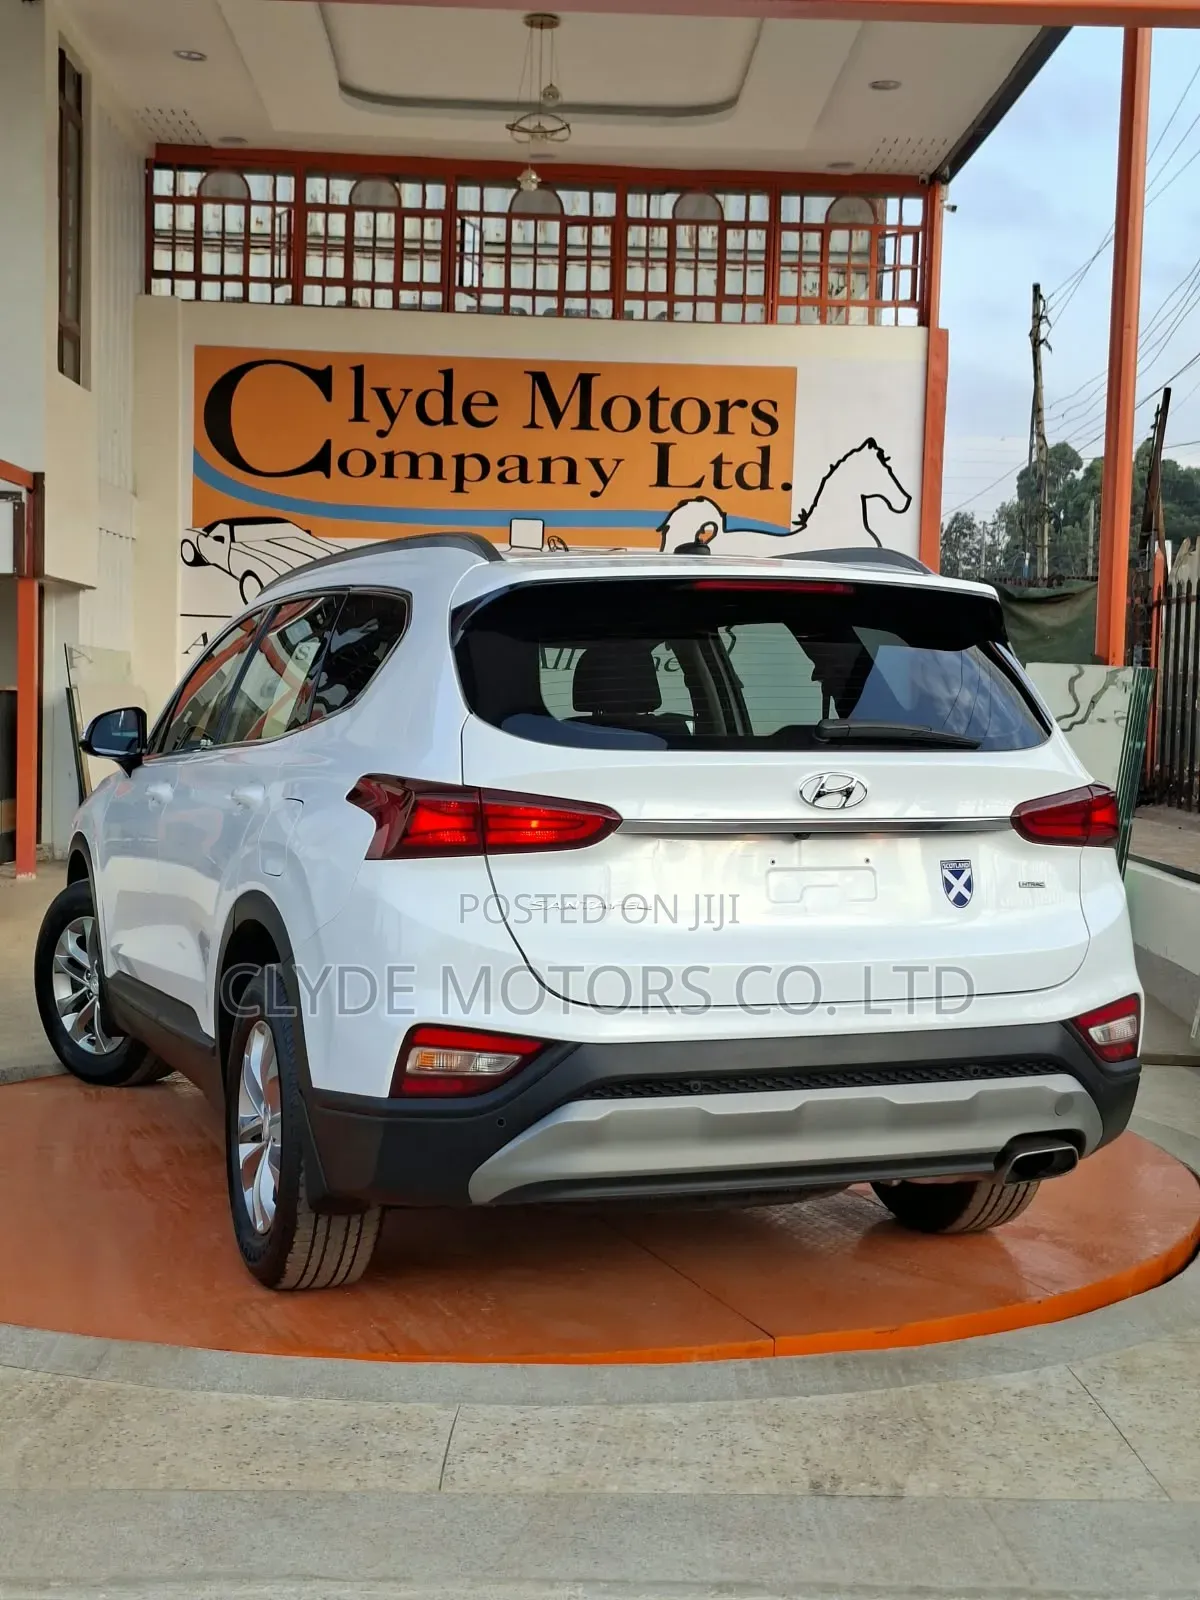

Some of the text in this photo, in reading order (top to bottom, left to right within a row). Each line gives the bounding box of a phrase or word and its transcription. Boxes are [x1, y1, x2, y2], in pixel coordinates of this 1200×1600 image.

[203, 358, 780, 479] Clyde Motors
[649, 441, 793, 492] Ltd.
